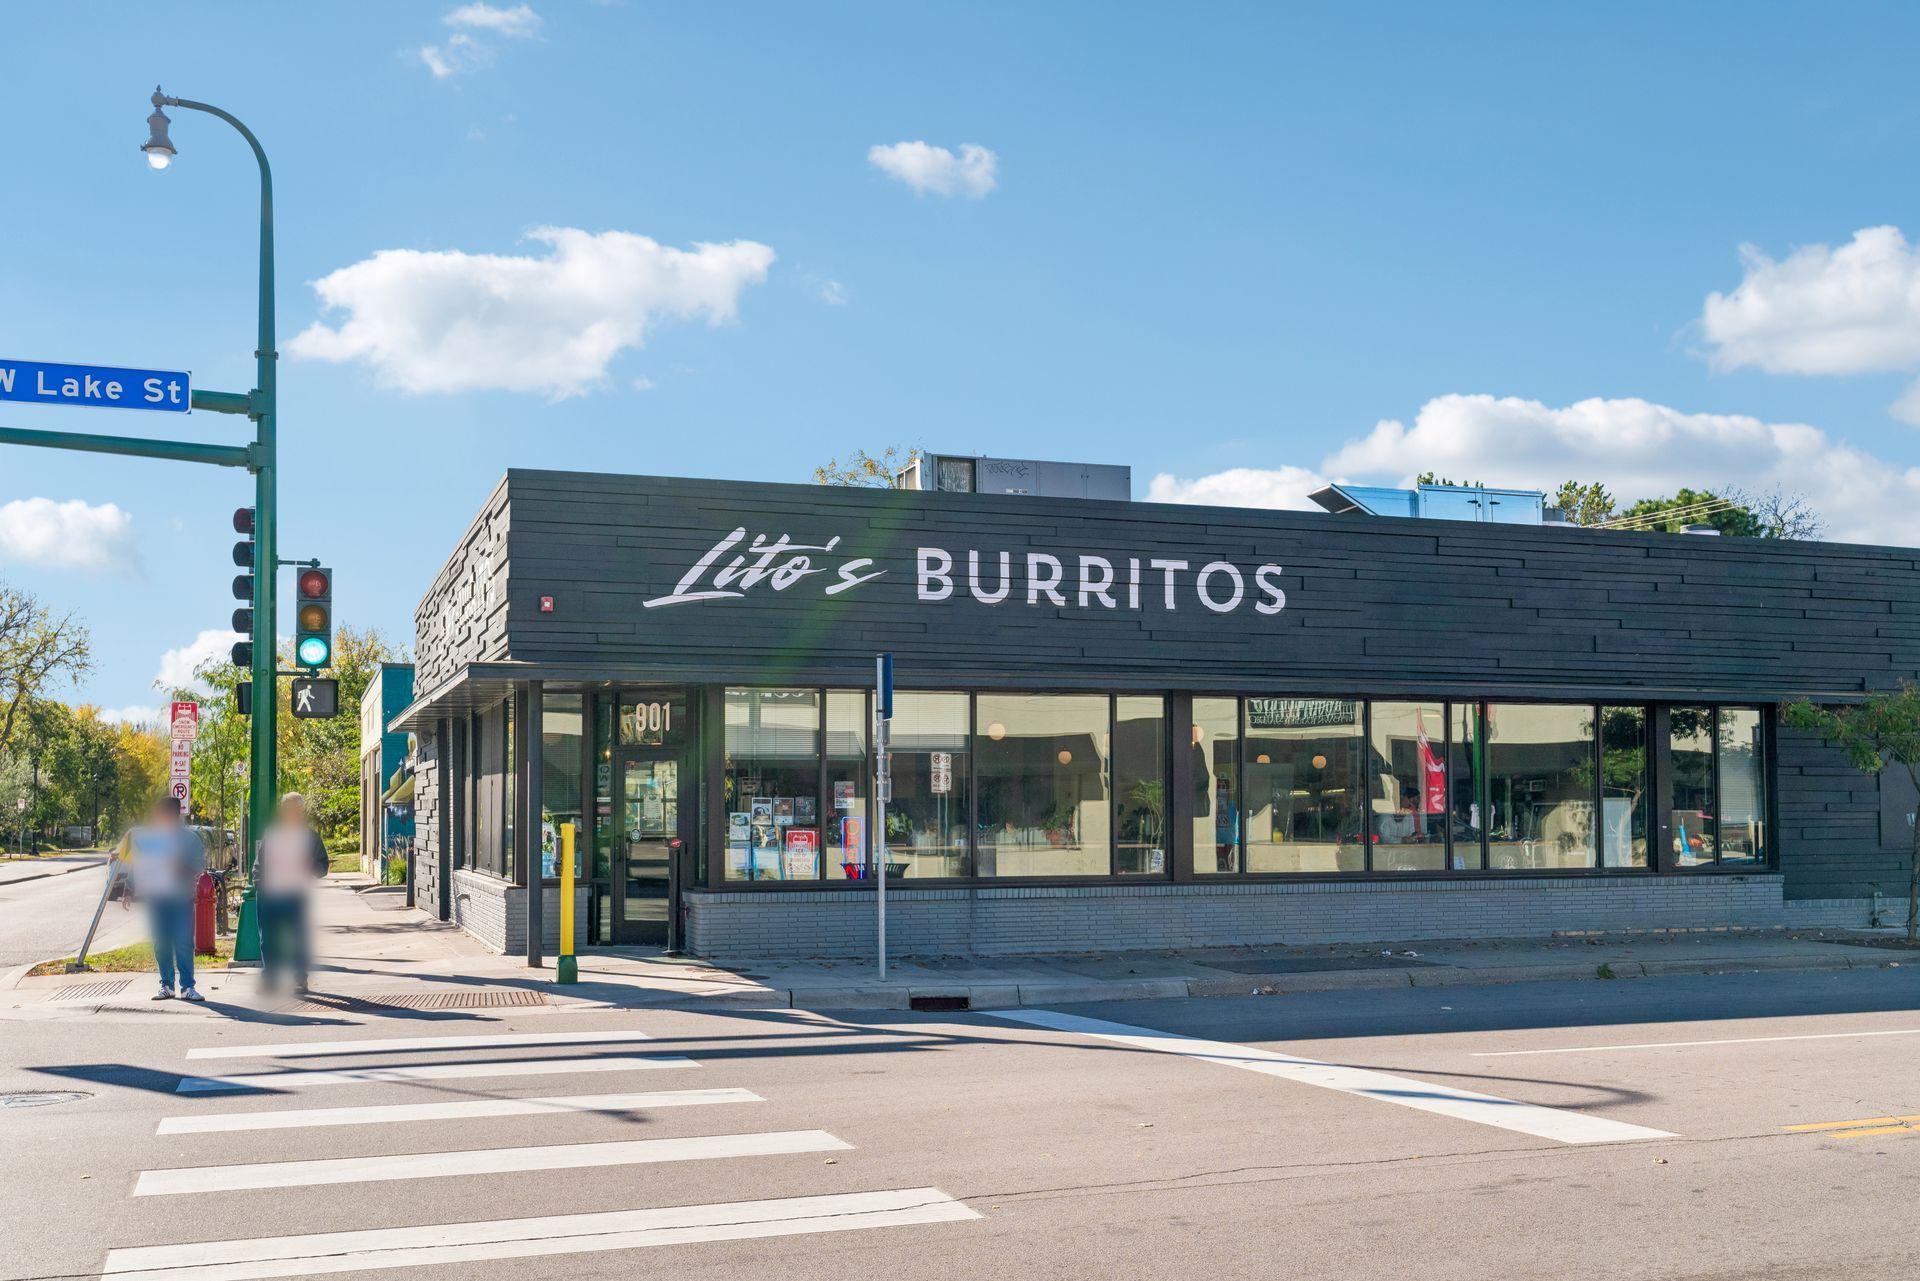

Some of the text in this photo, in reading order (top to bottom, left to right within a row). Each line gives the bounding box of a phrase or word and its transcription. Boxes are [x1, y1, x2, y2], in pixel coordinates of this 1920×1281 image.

[37, 371, 123, 400] Lake
[144, 378, 181, 404] St
[642, 526, 1287, 615] Lito's BURRITOS
[635, 701, 671, 732] 901
